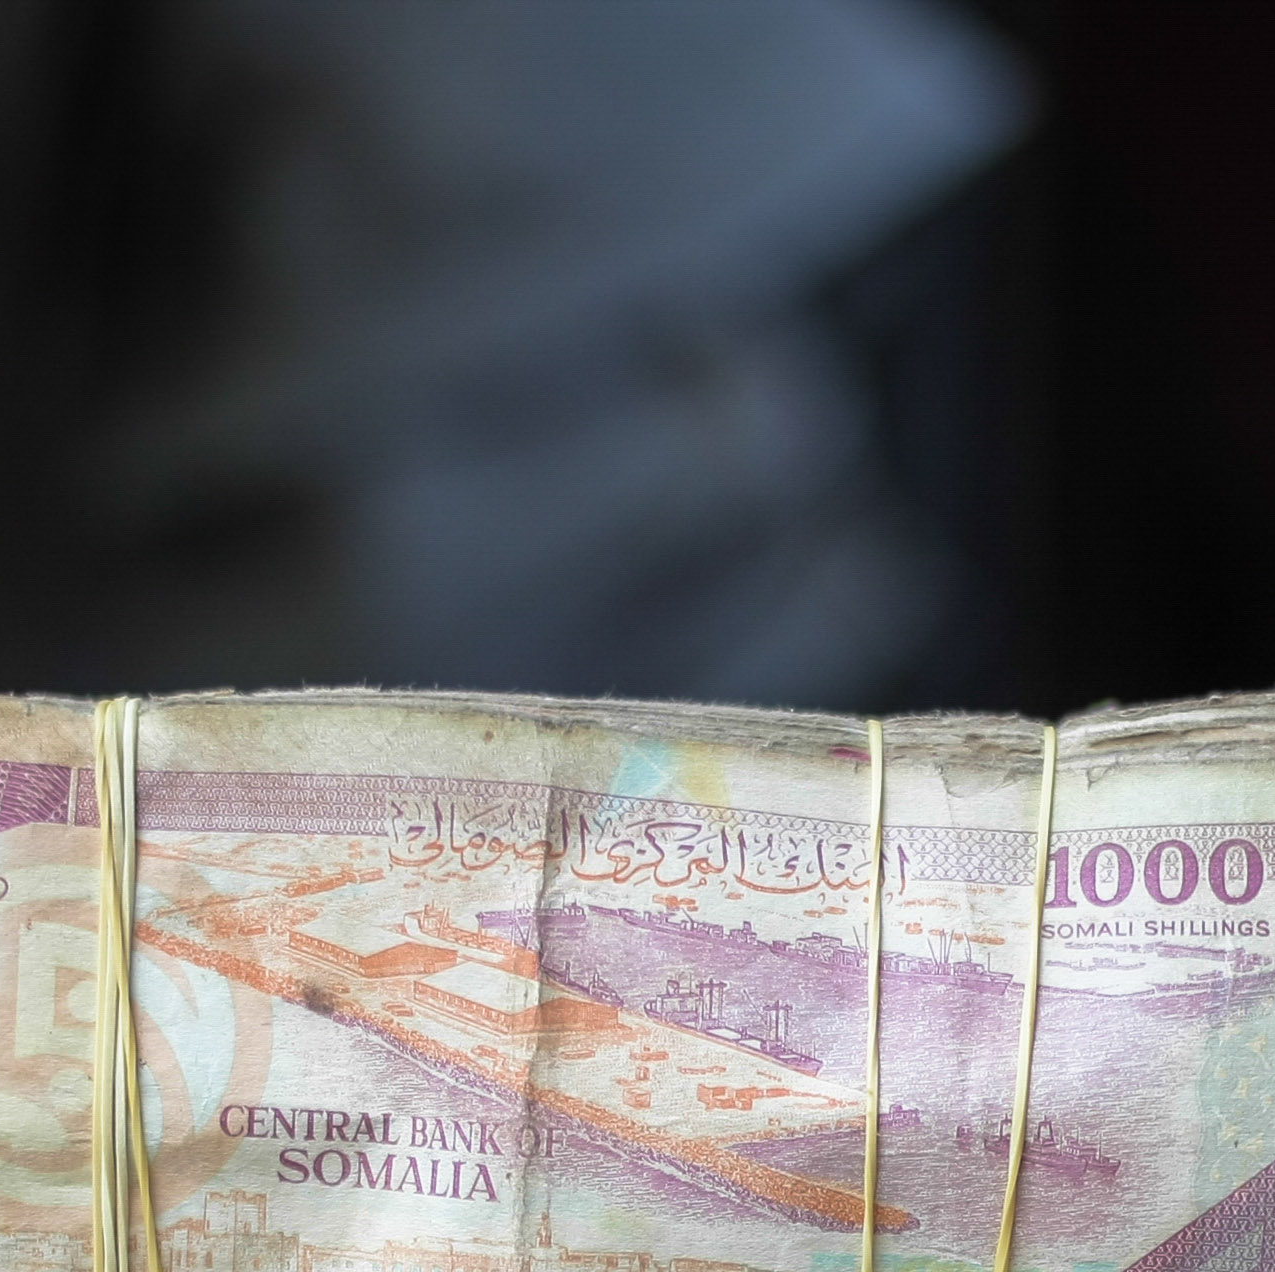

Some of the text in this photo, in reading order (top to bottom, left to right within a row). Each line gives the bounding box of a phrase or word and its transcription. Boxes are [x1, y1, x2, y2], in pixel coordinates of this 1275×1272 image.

[1045, 838, 1264, 908] 1000
[1041, 919, 1271, 940] SOMALI SHILLINGS
[219, 1105, 567, 1159] CENTRAL BANK OF
[277, 1148, 501, 1203] SOMALIA
